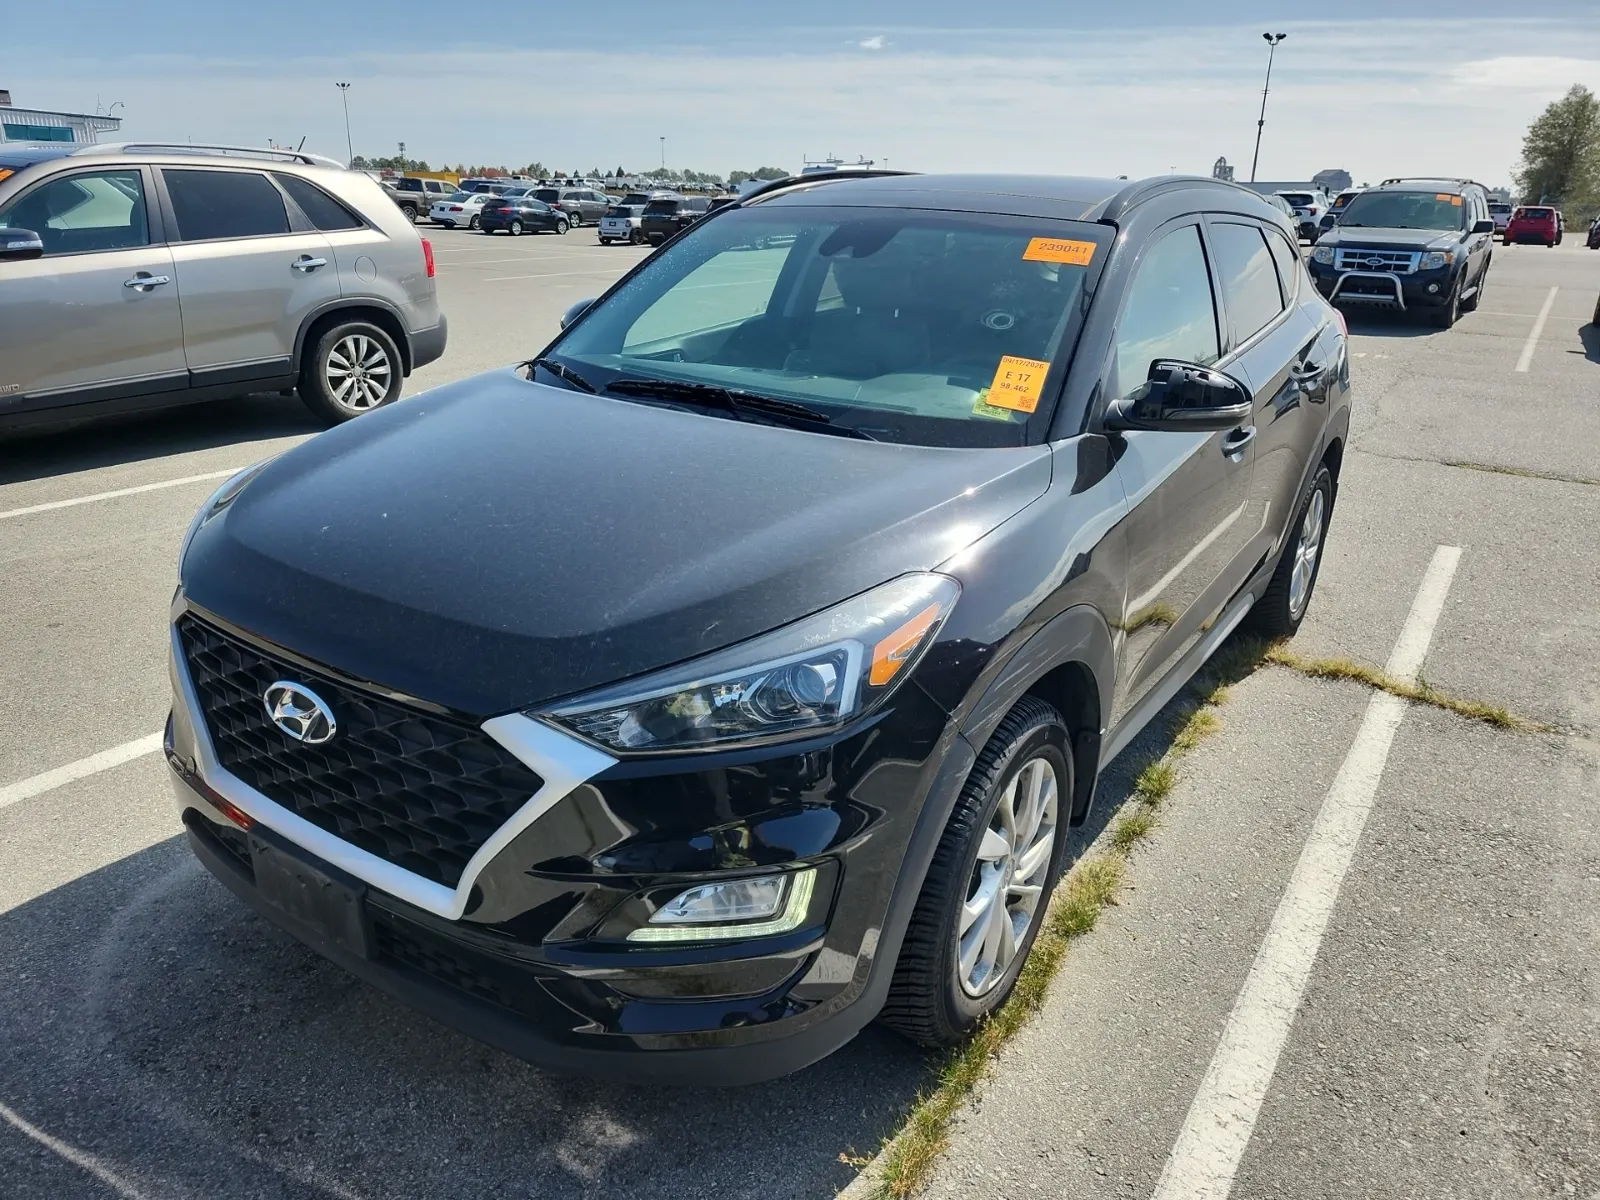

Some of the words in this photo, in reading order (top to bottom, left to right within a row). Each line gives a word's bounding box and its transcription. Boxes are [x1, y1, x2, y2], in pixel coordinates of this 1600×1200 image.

[1038, 243, 1087, 254] 239041
[1005, 371, 1013, 379] E
[1018, 373, 1031, 382] 17
